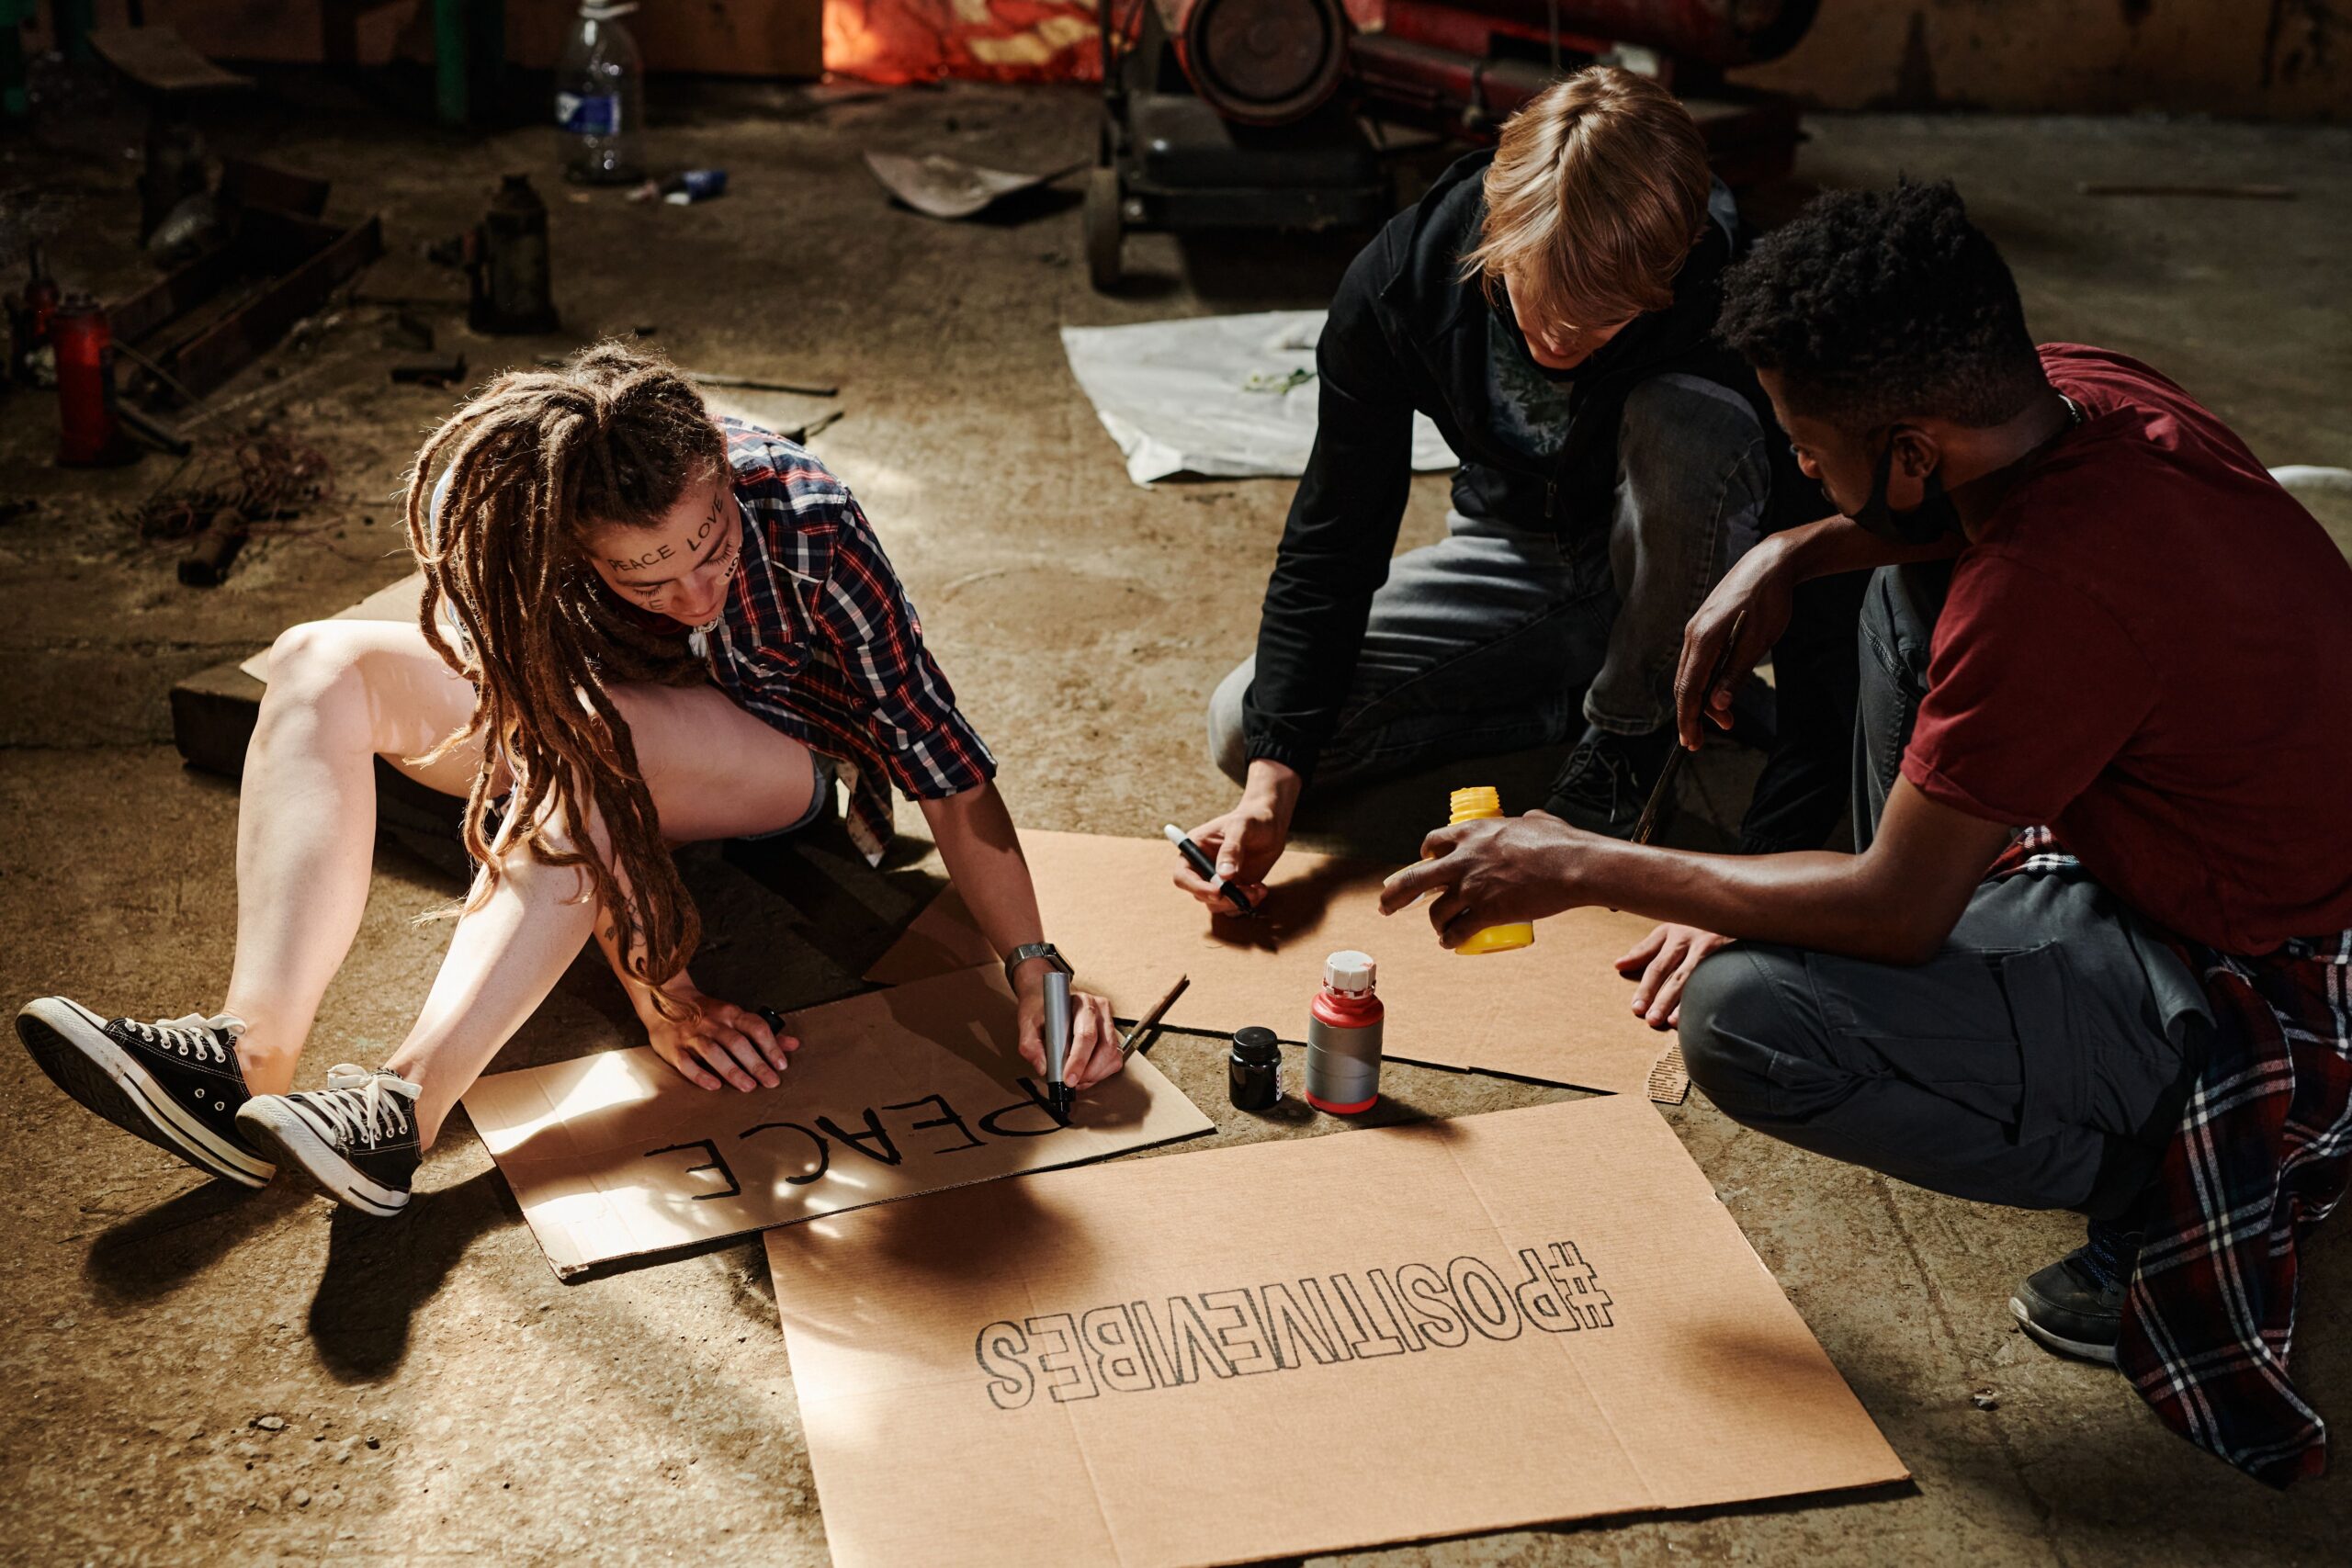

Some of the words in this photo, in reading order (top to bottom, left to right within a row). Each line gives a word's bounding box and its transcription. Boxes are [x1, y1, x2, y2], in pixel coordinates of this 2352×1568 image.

[607, 544, 675, 572] PEACE
[686, 492, 723, 552] LOVE
[643, 1077, 1073, 1201] PEACE
[975, 1240, 1614, 1410] #POSITIVEVIBES
